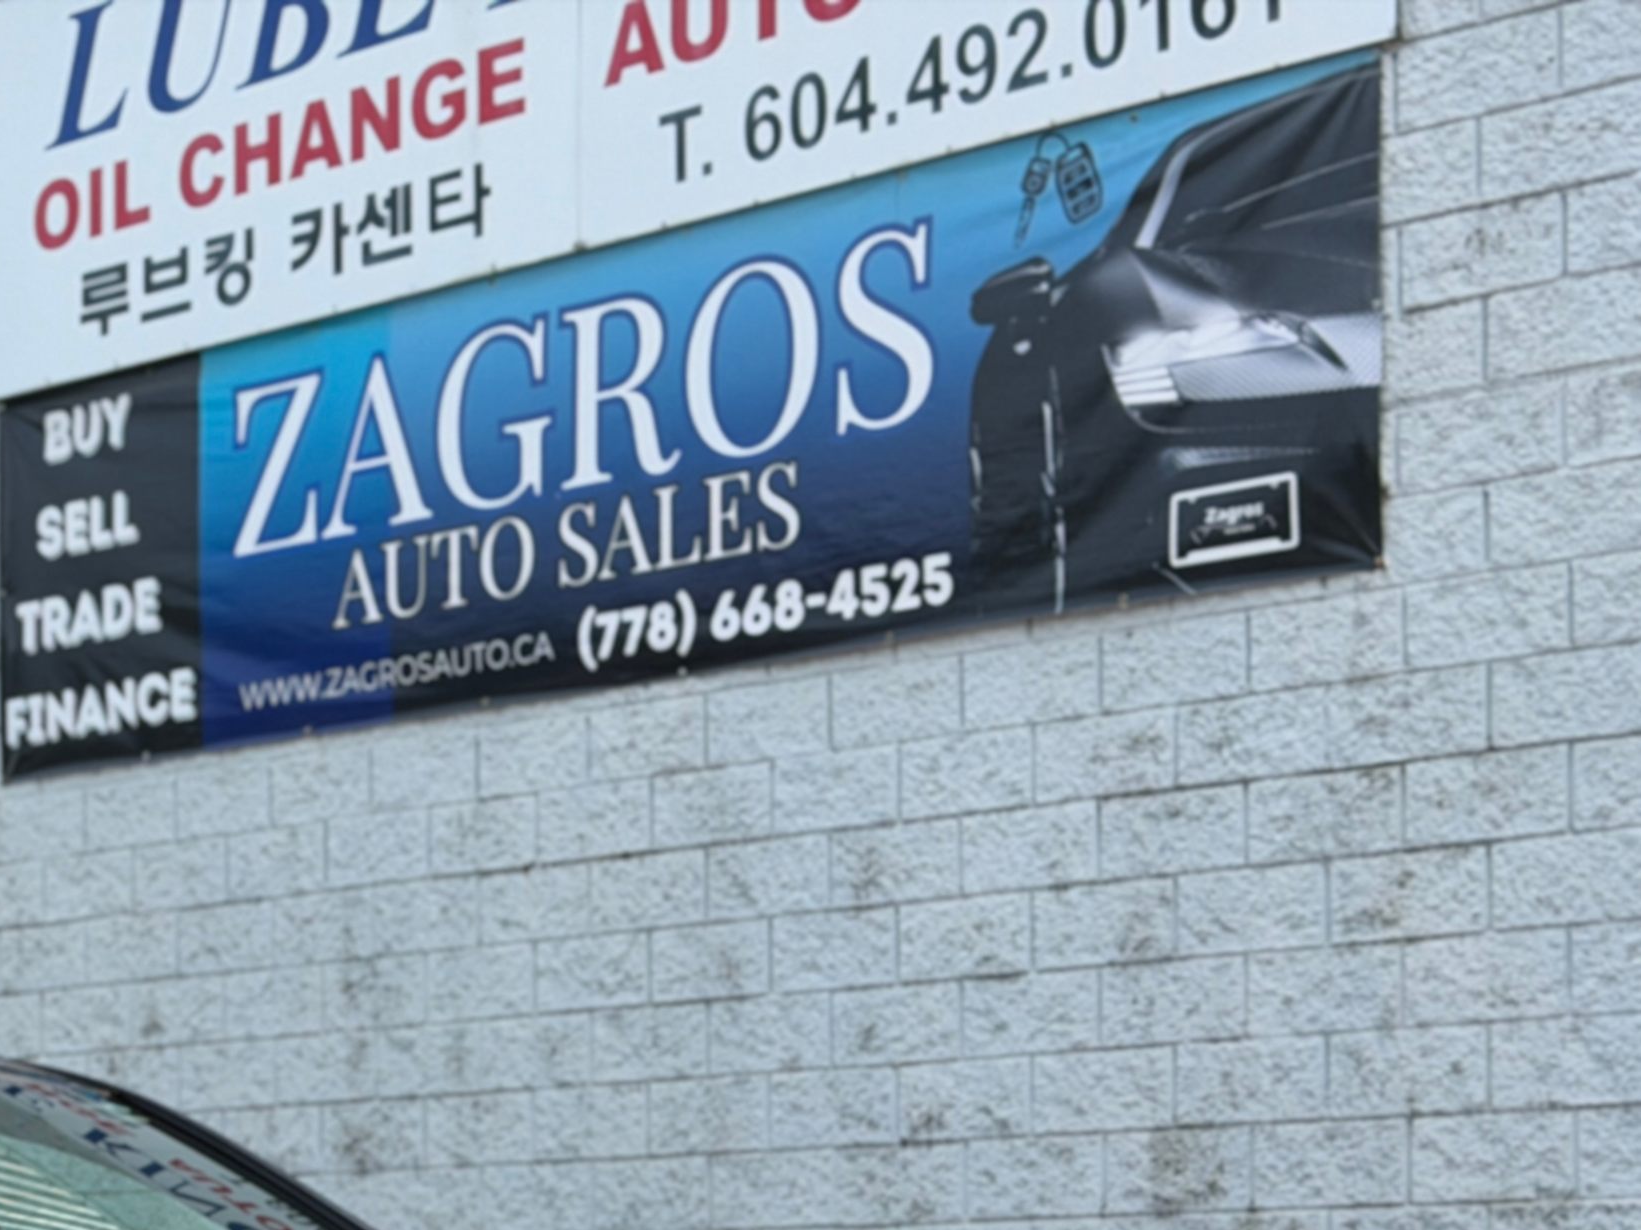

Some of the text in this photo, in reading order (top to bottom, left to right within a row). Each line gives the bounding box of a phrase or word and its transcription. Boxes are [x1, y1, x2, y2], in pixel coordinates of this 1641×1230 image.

[604, 0, 860, 87] AU
[659, 0, 1280, 182] T. 604.492.016
[34, 38, 526, 250] OIL CHANGE
[78, 163, 491, 336] 루브킹 카센타
[43, 394, 132, 466] BUY
[233, 215, 935, 557] ZAGROS
[36, 490, 139, 561] SELL
[332, 461, 803, 630] AUTO SALES
[16, 577, 162, 655] TRADE
[238, 553, 954, 712] WWW.ZAGROSAUTO.CA (778) 668-4525
[6, 668, 198, 751] FINANCE
